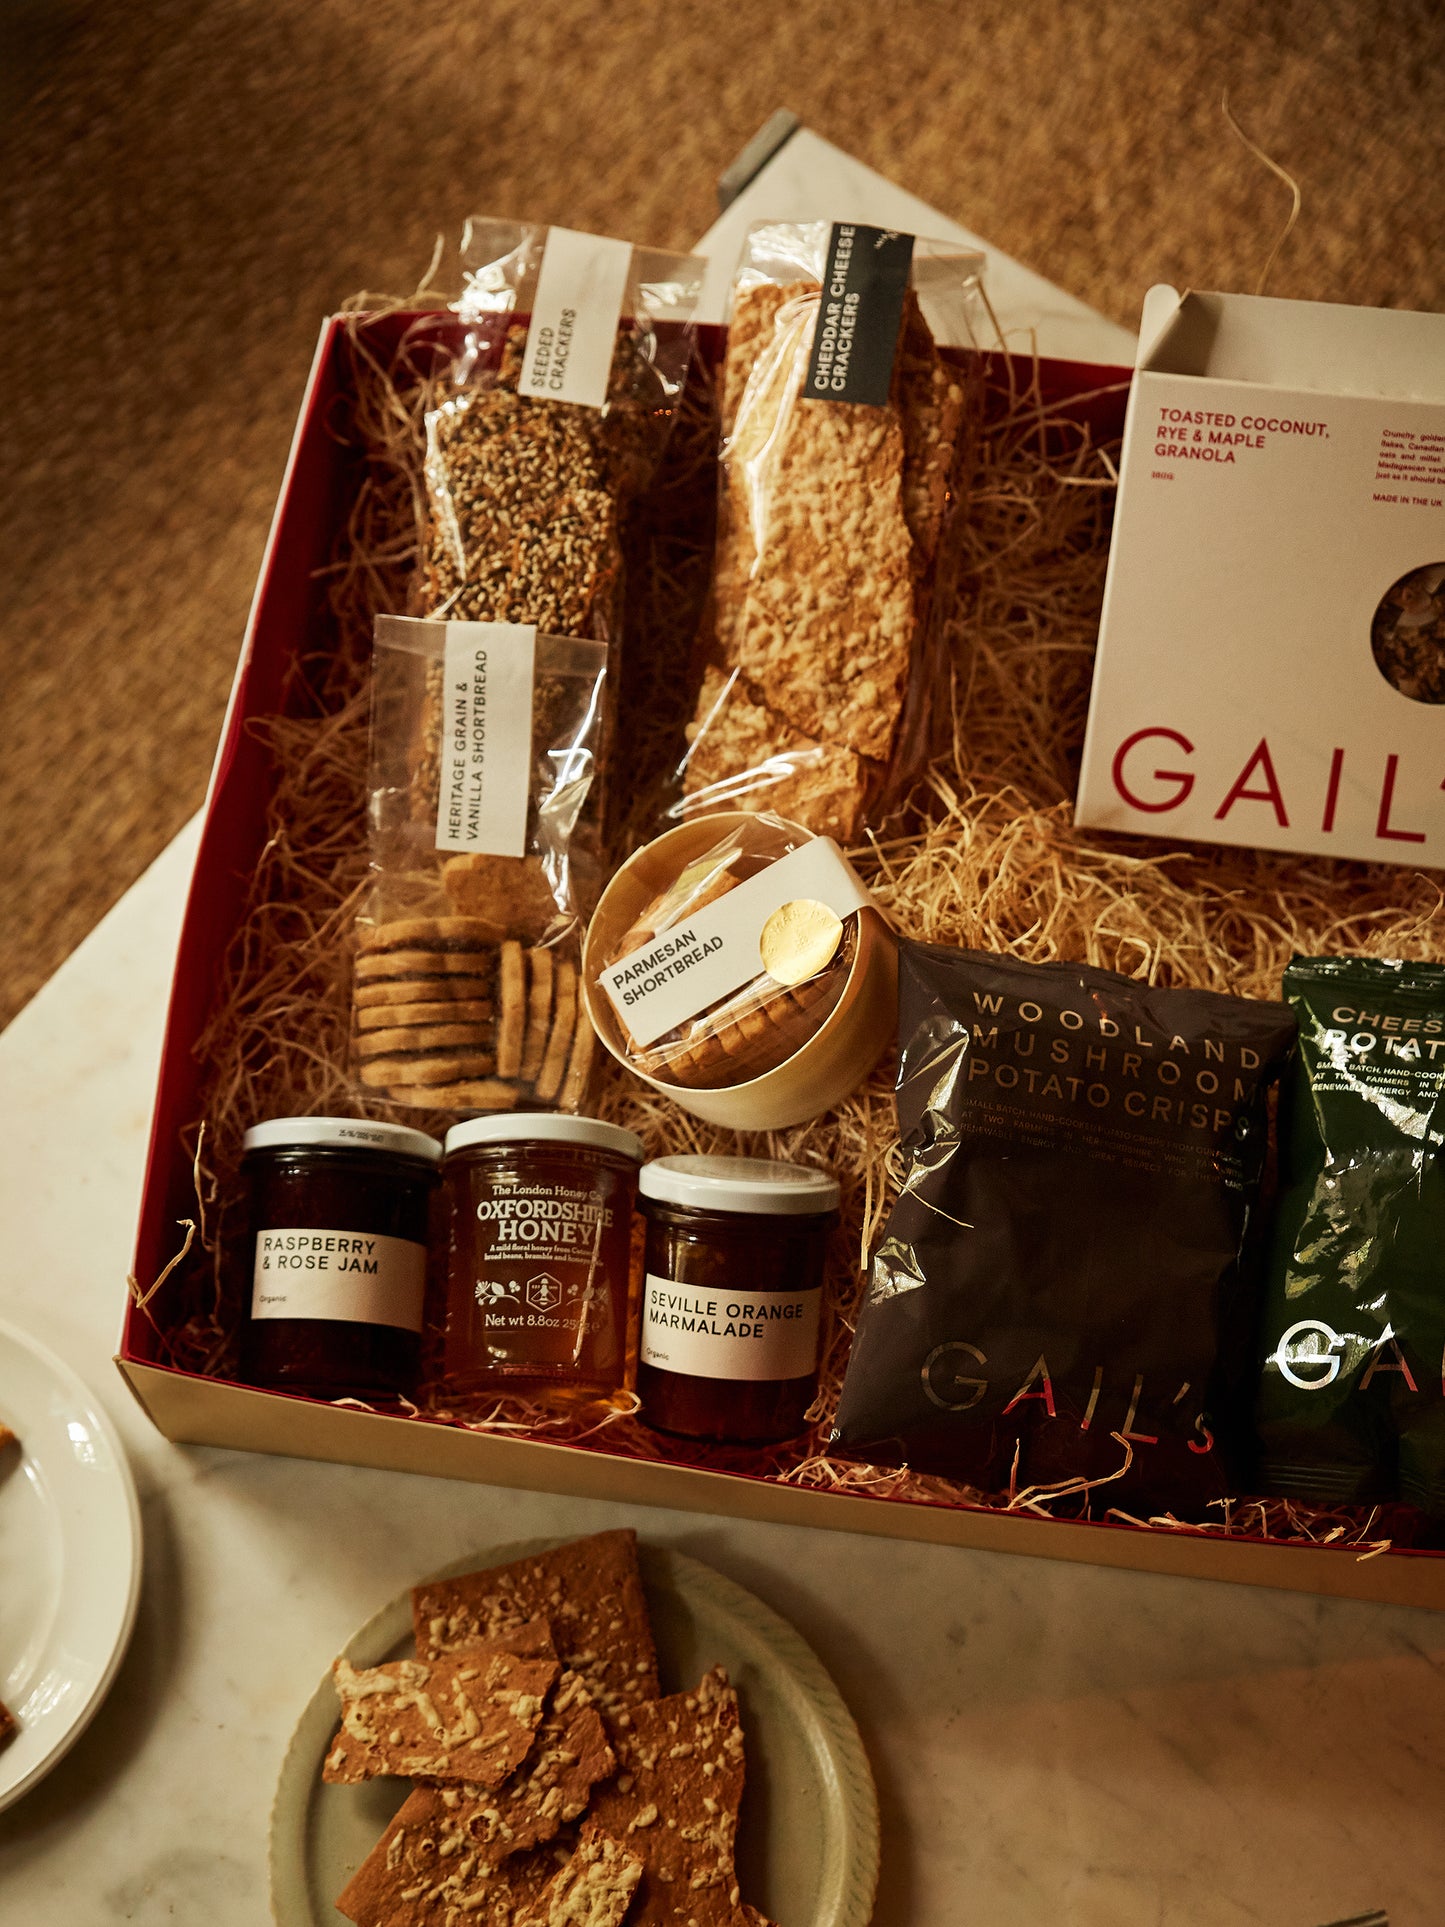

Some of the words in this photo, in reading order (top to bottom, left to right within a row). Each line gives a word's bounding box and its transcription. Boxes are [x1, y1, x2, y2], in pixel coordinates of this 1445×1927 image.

[814, 303, 841, 391] CHEDDAR
[829, 225, 856, 298] CHEESE
[531, 326, 554, 388] SEEDED
[549, 308, 577, 392] CRACKERS
[831, 292, 860, 392] CRACKERS
[1157, 426, 1188, 440] RYE
[1192, 428, 1203, 443] &
[1208, 430, 1265, 448] MAPLE
[1159, 407, 1236, 428] TOASTED
[1241, 416, 1330, 439] COCONUT,
[1154, 444, 1236, 464] GRANOLA
[1373, 494, 1397, 503] MADE
[1400, 496, 1409, 504] IN
[1412, 497, 1428, 506] THE
[1430, 499, 1443, 507] UK
[456, 682, 468, 692] &
[472, 650, 488, 764] SHORTBREAD
[455, 699, 468, 752] GRAIN
[448, 759, 466, 839] HERITAGE
[467, 773, 483, 841] VANILLA
[612, 930, 698, 989] PARMESAN
[622, 935, 724, 1006] SHORTBREAD
[973, 992, 1260, 1070] WOODLAND
[968, 1058, 1110, 1108] POTATO
[1366, 1076, 1409, 1086] FARMERS
[1417, 1091, 1439, 1099] AND
[983, 1114, 1005, 1125] TWO
[1124, 1092, 1250, 1141] CRISPS
[492, 1185, 511, 1196] The
[513, 1185, 552, 1196] London
[555, 1186, 587, 1199] Honey
[264, 1236, 376, 1255] RASPBERRY
[498, 1219, 594, 1245] HONEY
[531, 1244, 553, 1254] honey
[262, 1256, 270, 1270] &
[278, 1255, 329, 1270] ROSE
[338, 1257, 379, 1274] JAM
[259, 1295, 287, 1304] Organic
[651, 1290, 718, 1316] SEVILLE
[726, 1303, 803, 1320] ORANGE
[485, 1314, 506, 1327] Net
[508, 1316, 525, 1327] wt
[527, 1314, 560, 1328] 8.8oz
[649, 1308, 765, 1338] MARMALADE
[646, 1347, 670, 1361] Organic
